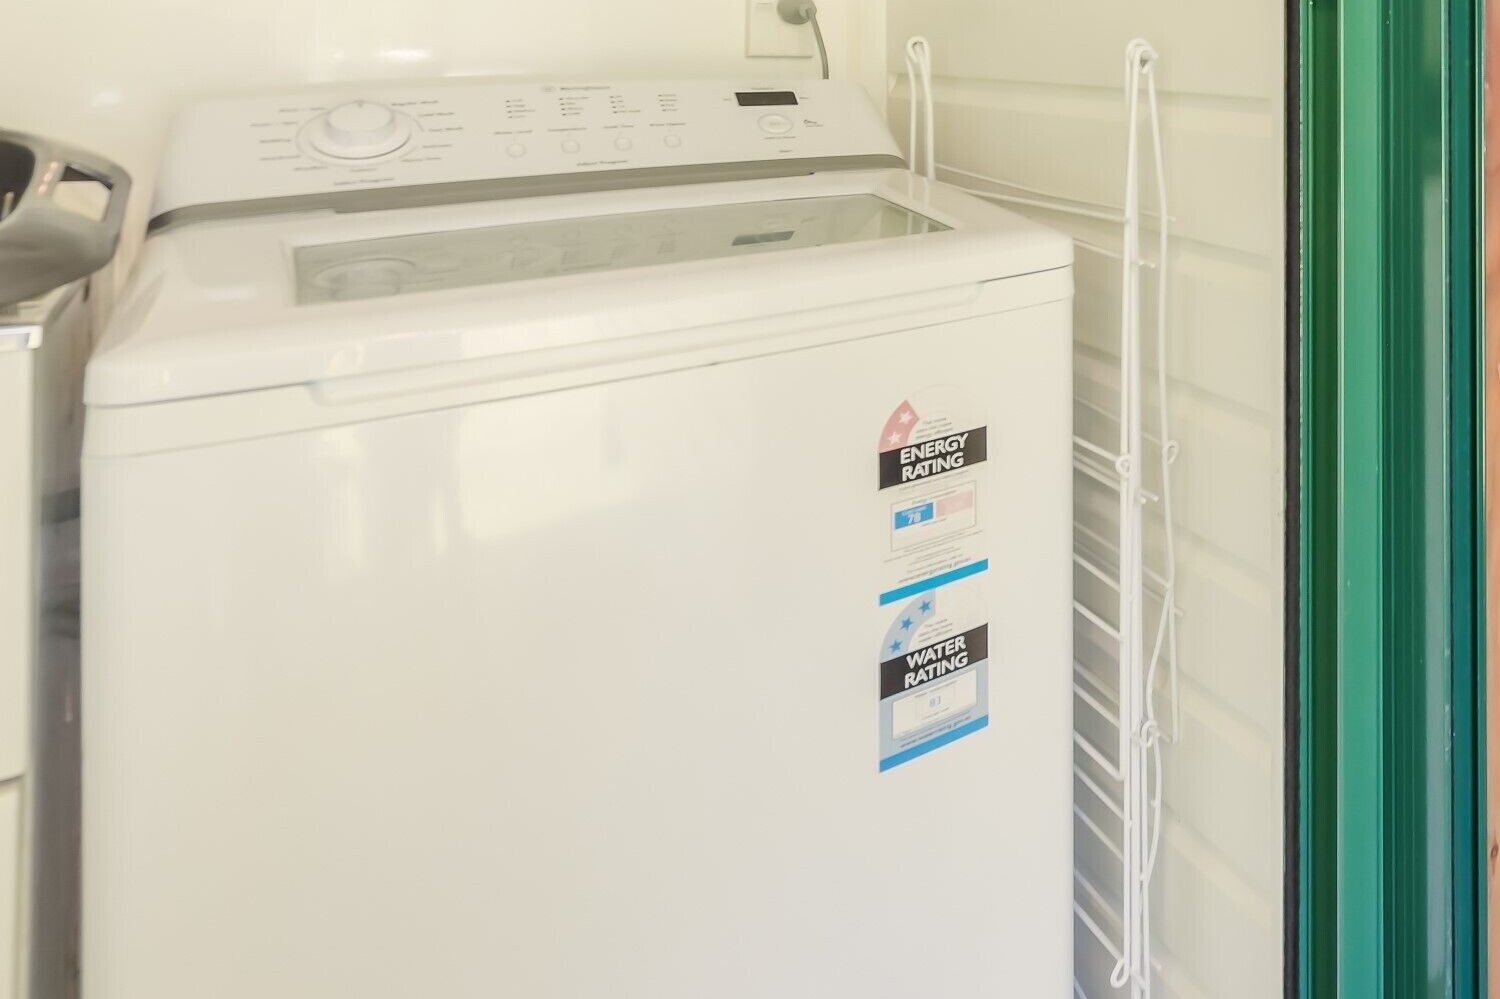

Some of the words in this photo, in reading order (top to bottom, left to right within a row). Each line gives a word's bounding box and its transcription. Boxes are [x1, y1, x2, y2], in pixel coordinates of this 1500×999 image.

[899, 432, 969, 465] ENERGY
[901, 451, 965, 482] RATING
[906, 635, 967, 670] WATER
[904, 651, 969, 689] RATING
